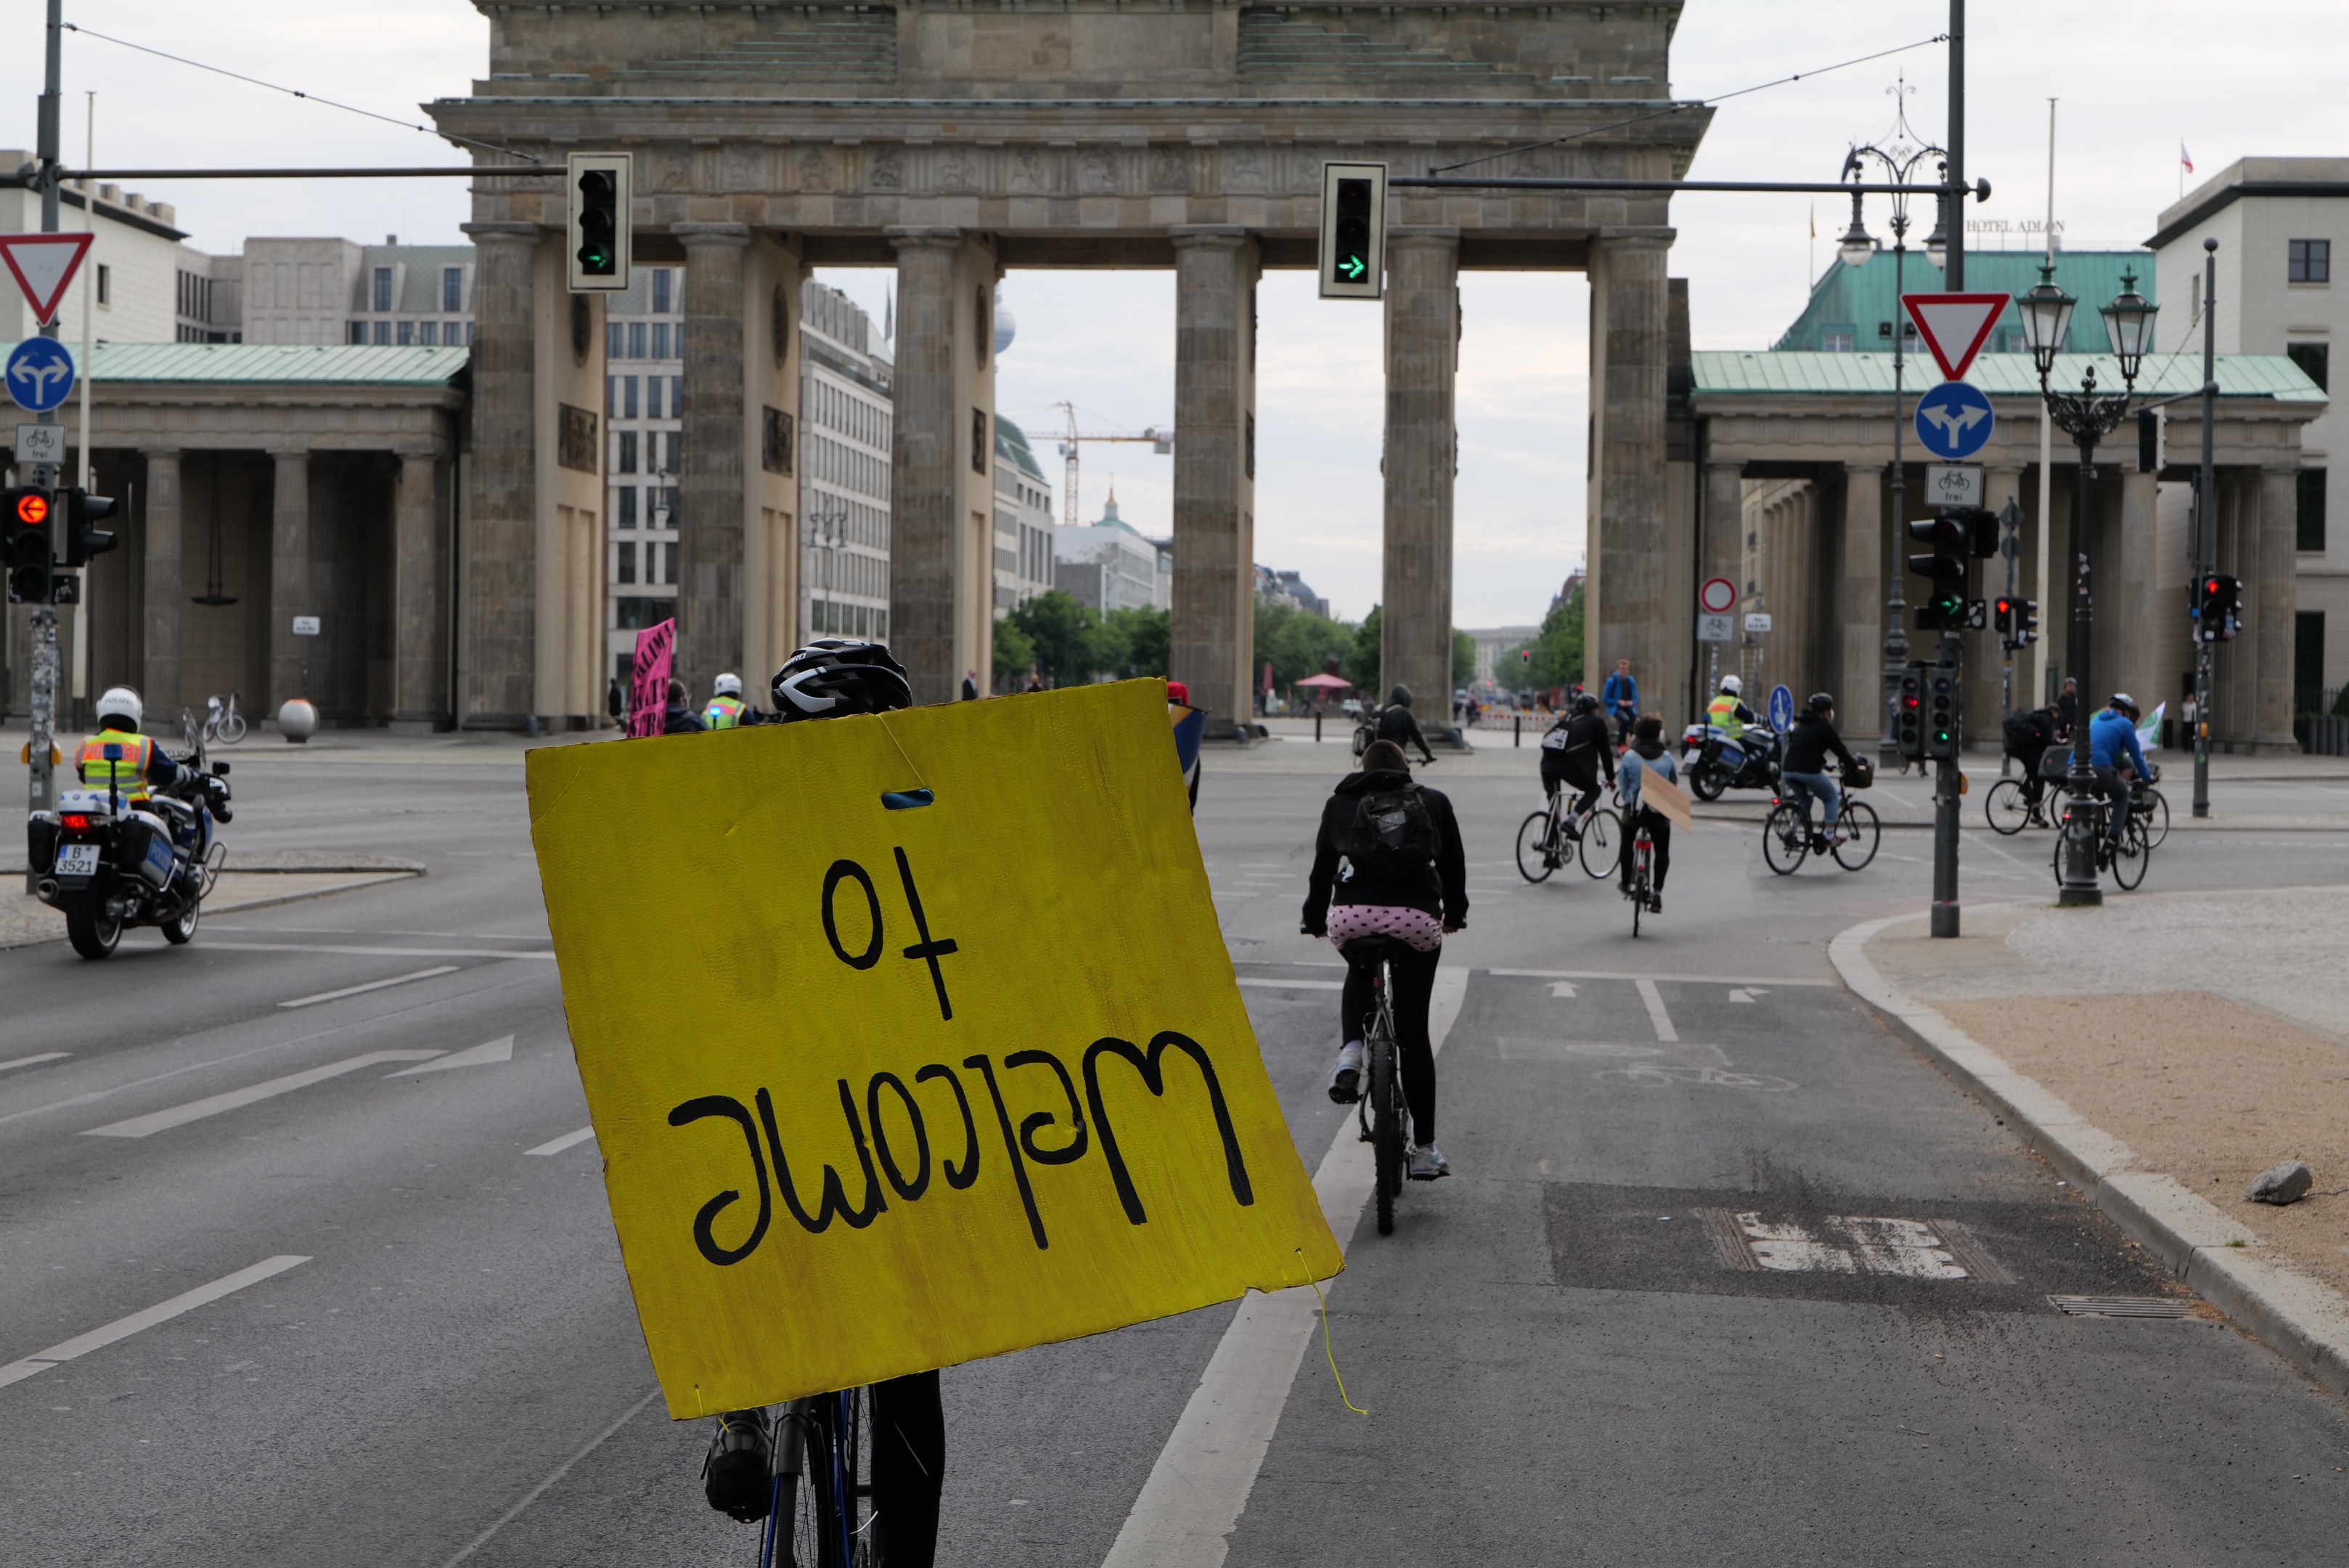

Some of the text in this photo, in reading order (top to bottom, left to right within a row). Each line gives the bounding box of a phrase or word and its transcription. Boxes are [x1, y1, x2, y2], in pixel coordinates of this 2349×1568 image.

[1966, 220, 2065, 232] HOTEL ADLN
[32, 449, 47, 459] frei
[1945, 491, 1962, 502] frei
[105, 696, 134, 706] POLIZEI
[83, 743, 136, 761] POEI
[72, 846, 81, 859] B
[58, 860, 92, 873] 3521
[822, 846, 958, 1021] to
[668, 1031, 1254, 1265] Welcome
